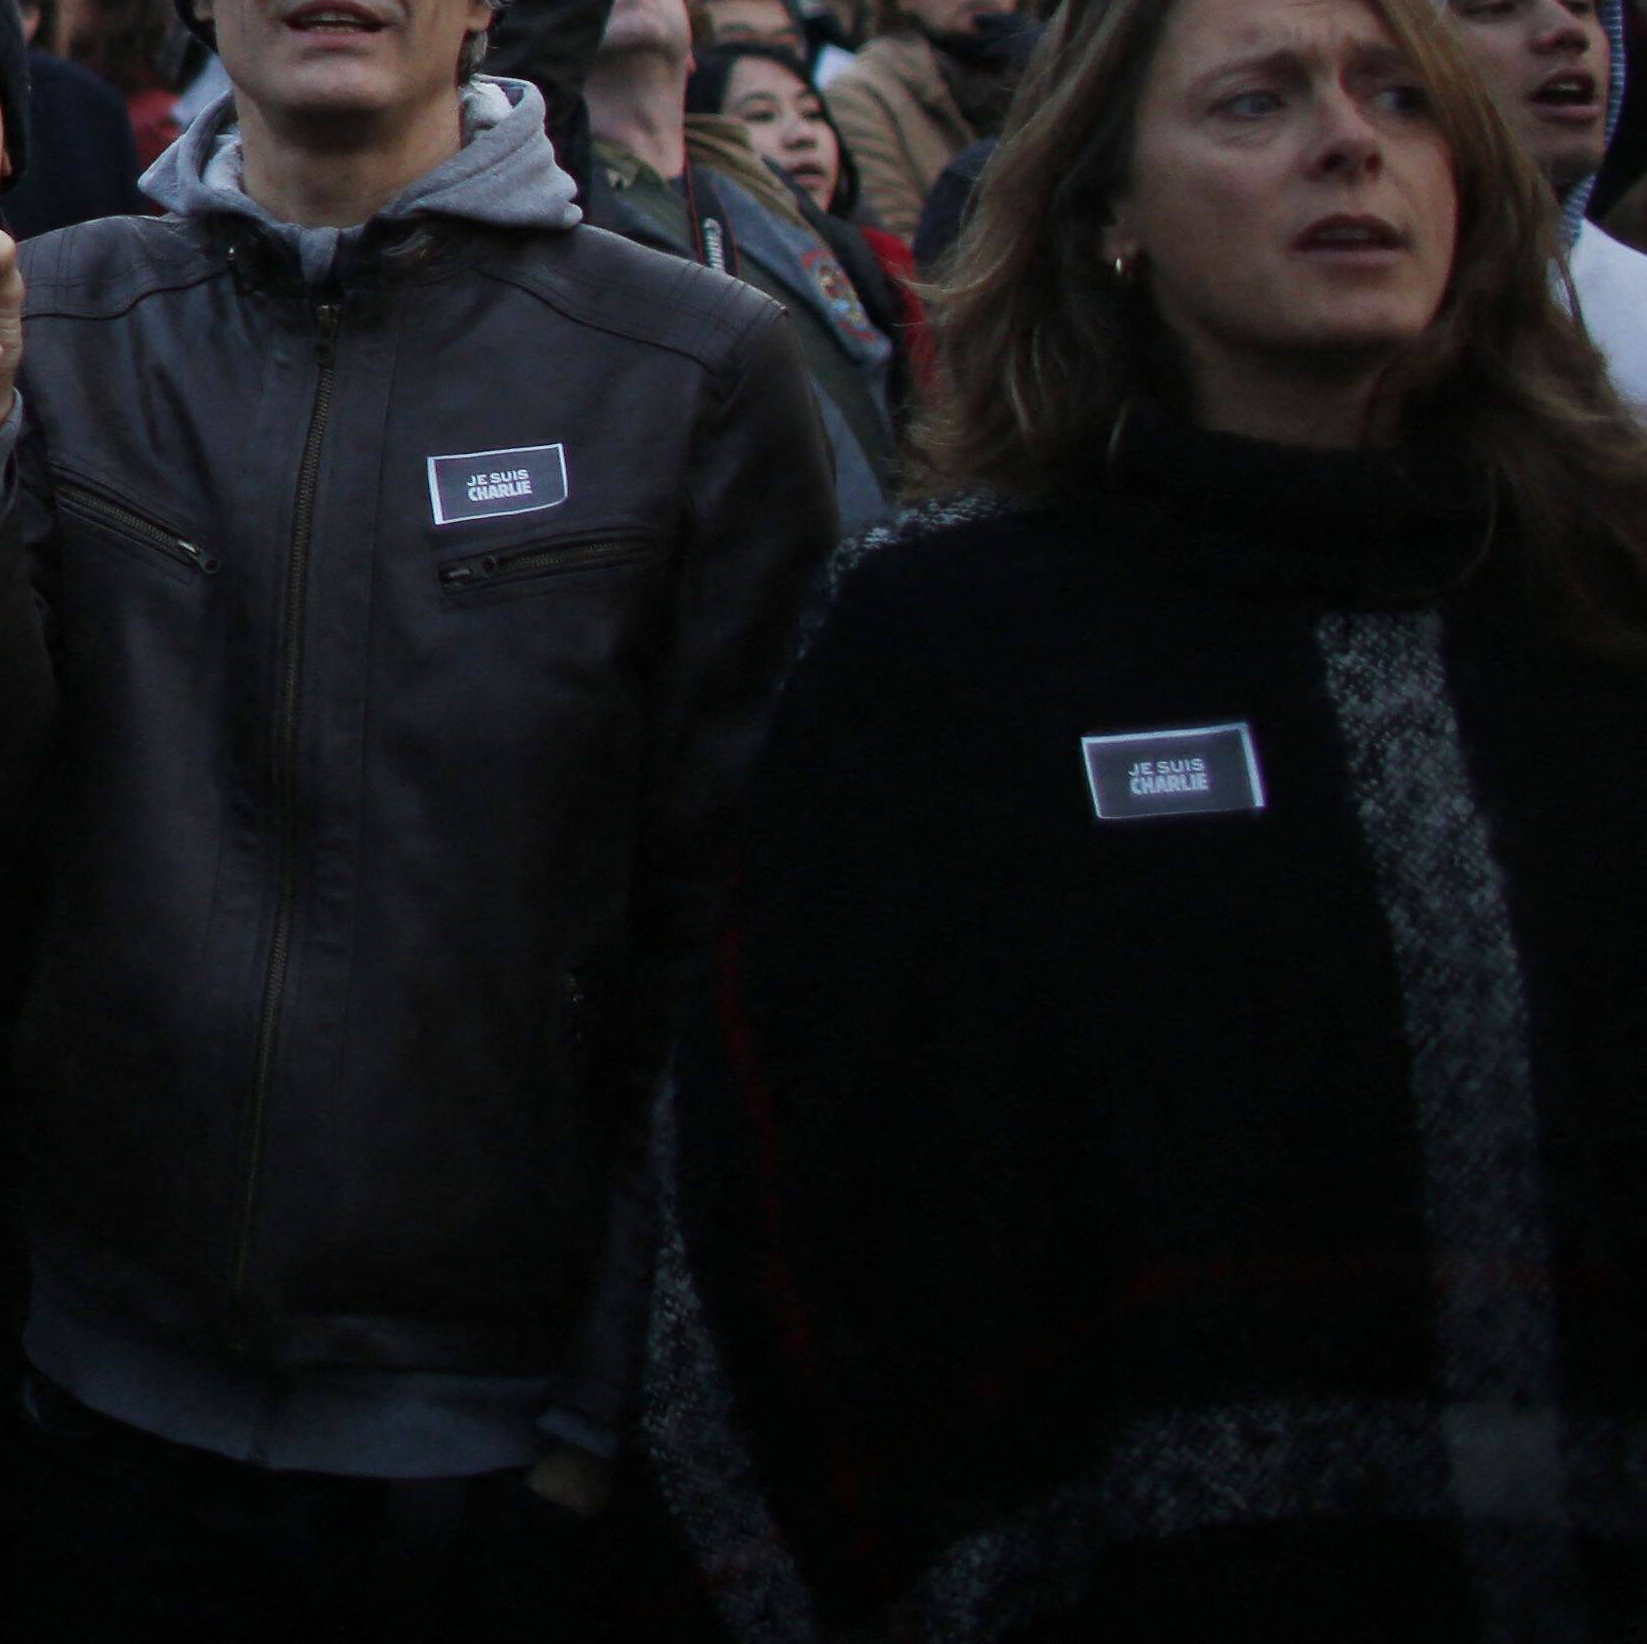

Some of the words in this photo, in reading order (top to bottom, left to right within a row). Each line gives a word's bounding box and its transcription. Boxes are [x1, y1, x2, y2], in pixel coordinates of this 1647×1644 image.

[468, 474, 487, 486] JE
[490, 469, 529, 483] SUIS
[468, 480, 532, 501] CHARLIE
[1129, 763, 1152, 776] JE
[1158, 758, 1204, 773] SUIS
[1130, 773, 1209, 795] CHARLIE
